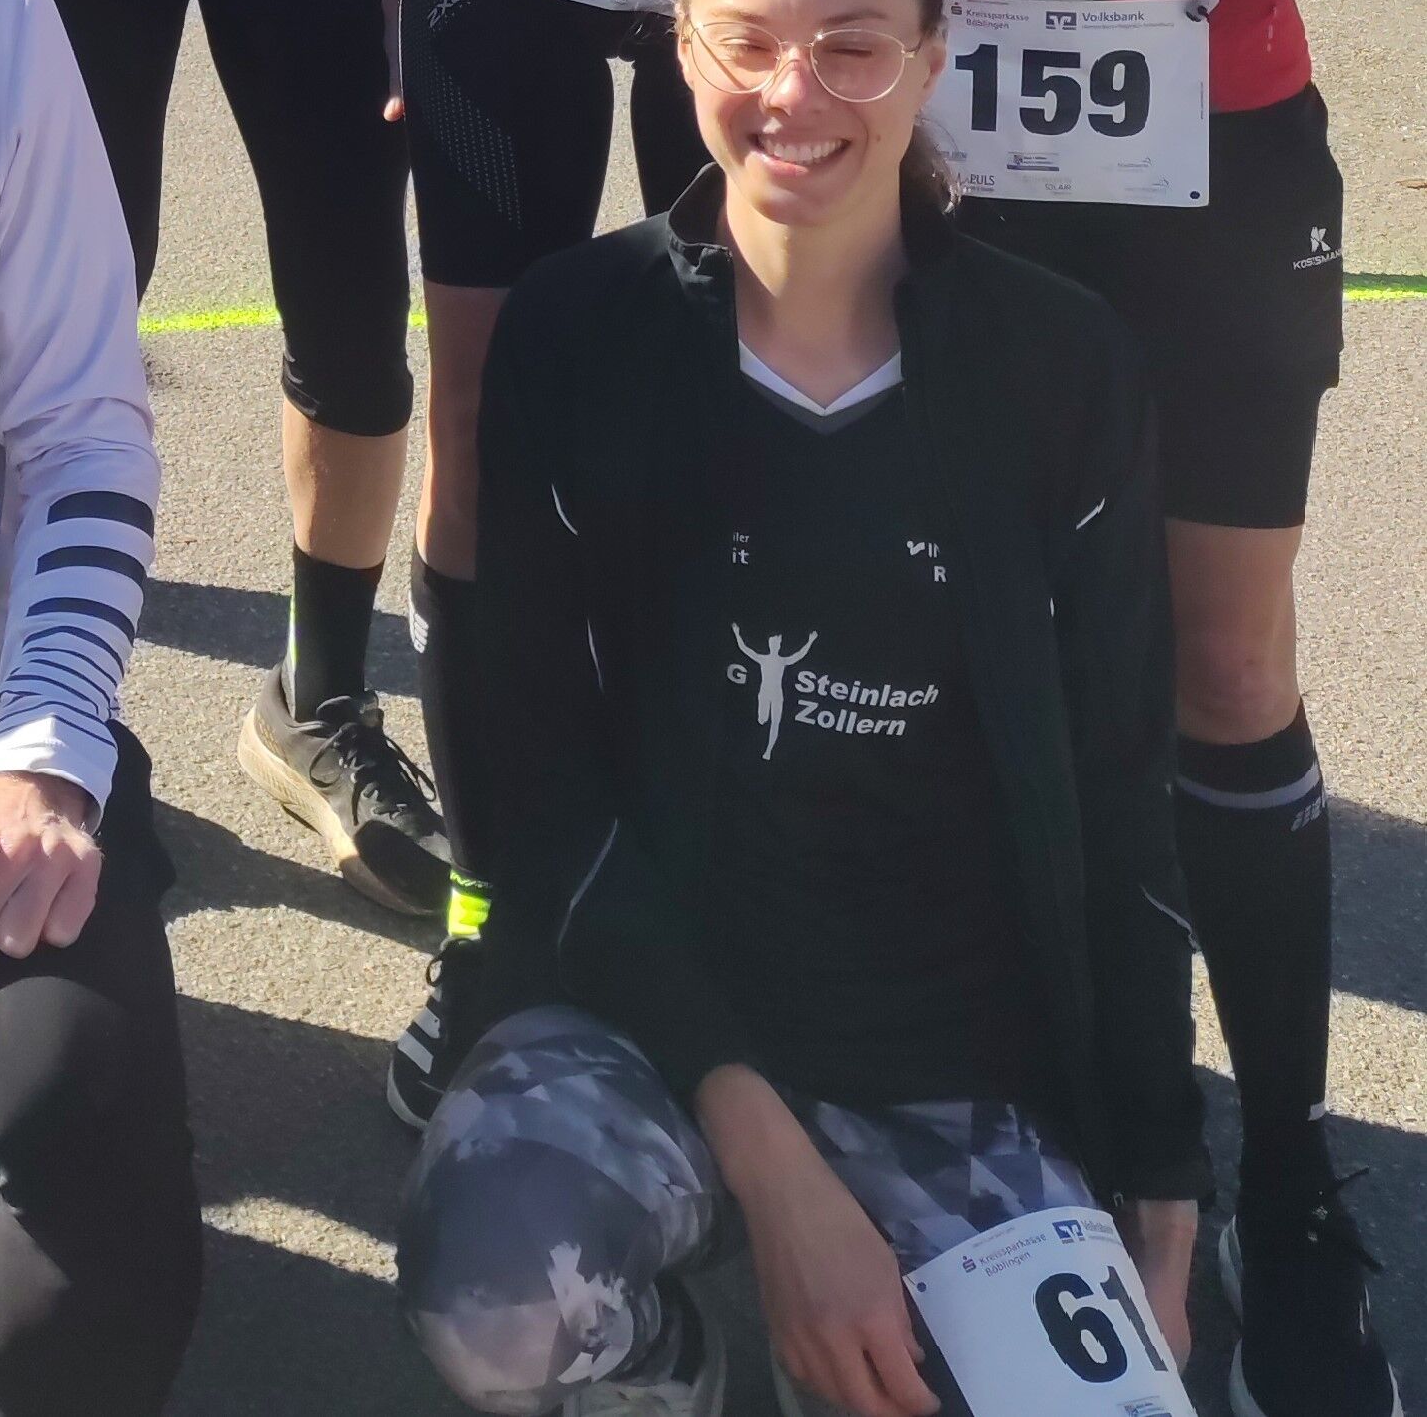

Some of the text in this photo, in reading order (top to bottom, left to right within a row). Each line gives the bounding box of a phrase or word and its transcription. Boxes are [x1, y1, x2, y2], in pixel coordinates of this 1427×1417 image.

[1082, 11, 1145, 22] Volksbank
[955, 44, 1150, 137] 159
[795, 670, 939, 708] Steinlach
[794, 699, 907, 736] Zollern
[1034, 1265, 1169, 1384] 61
